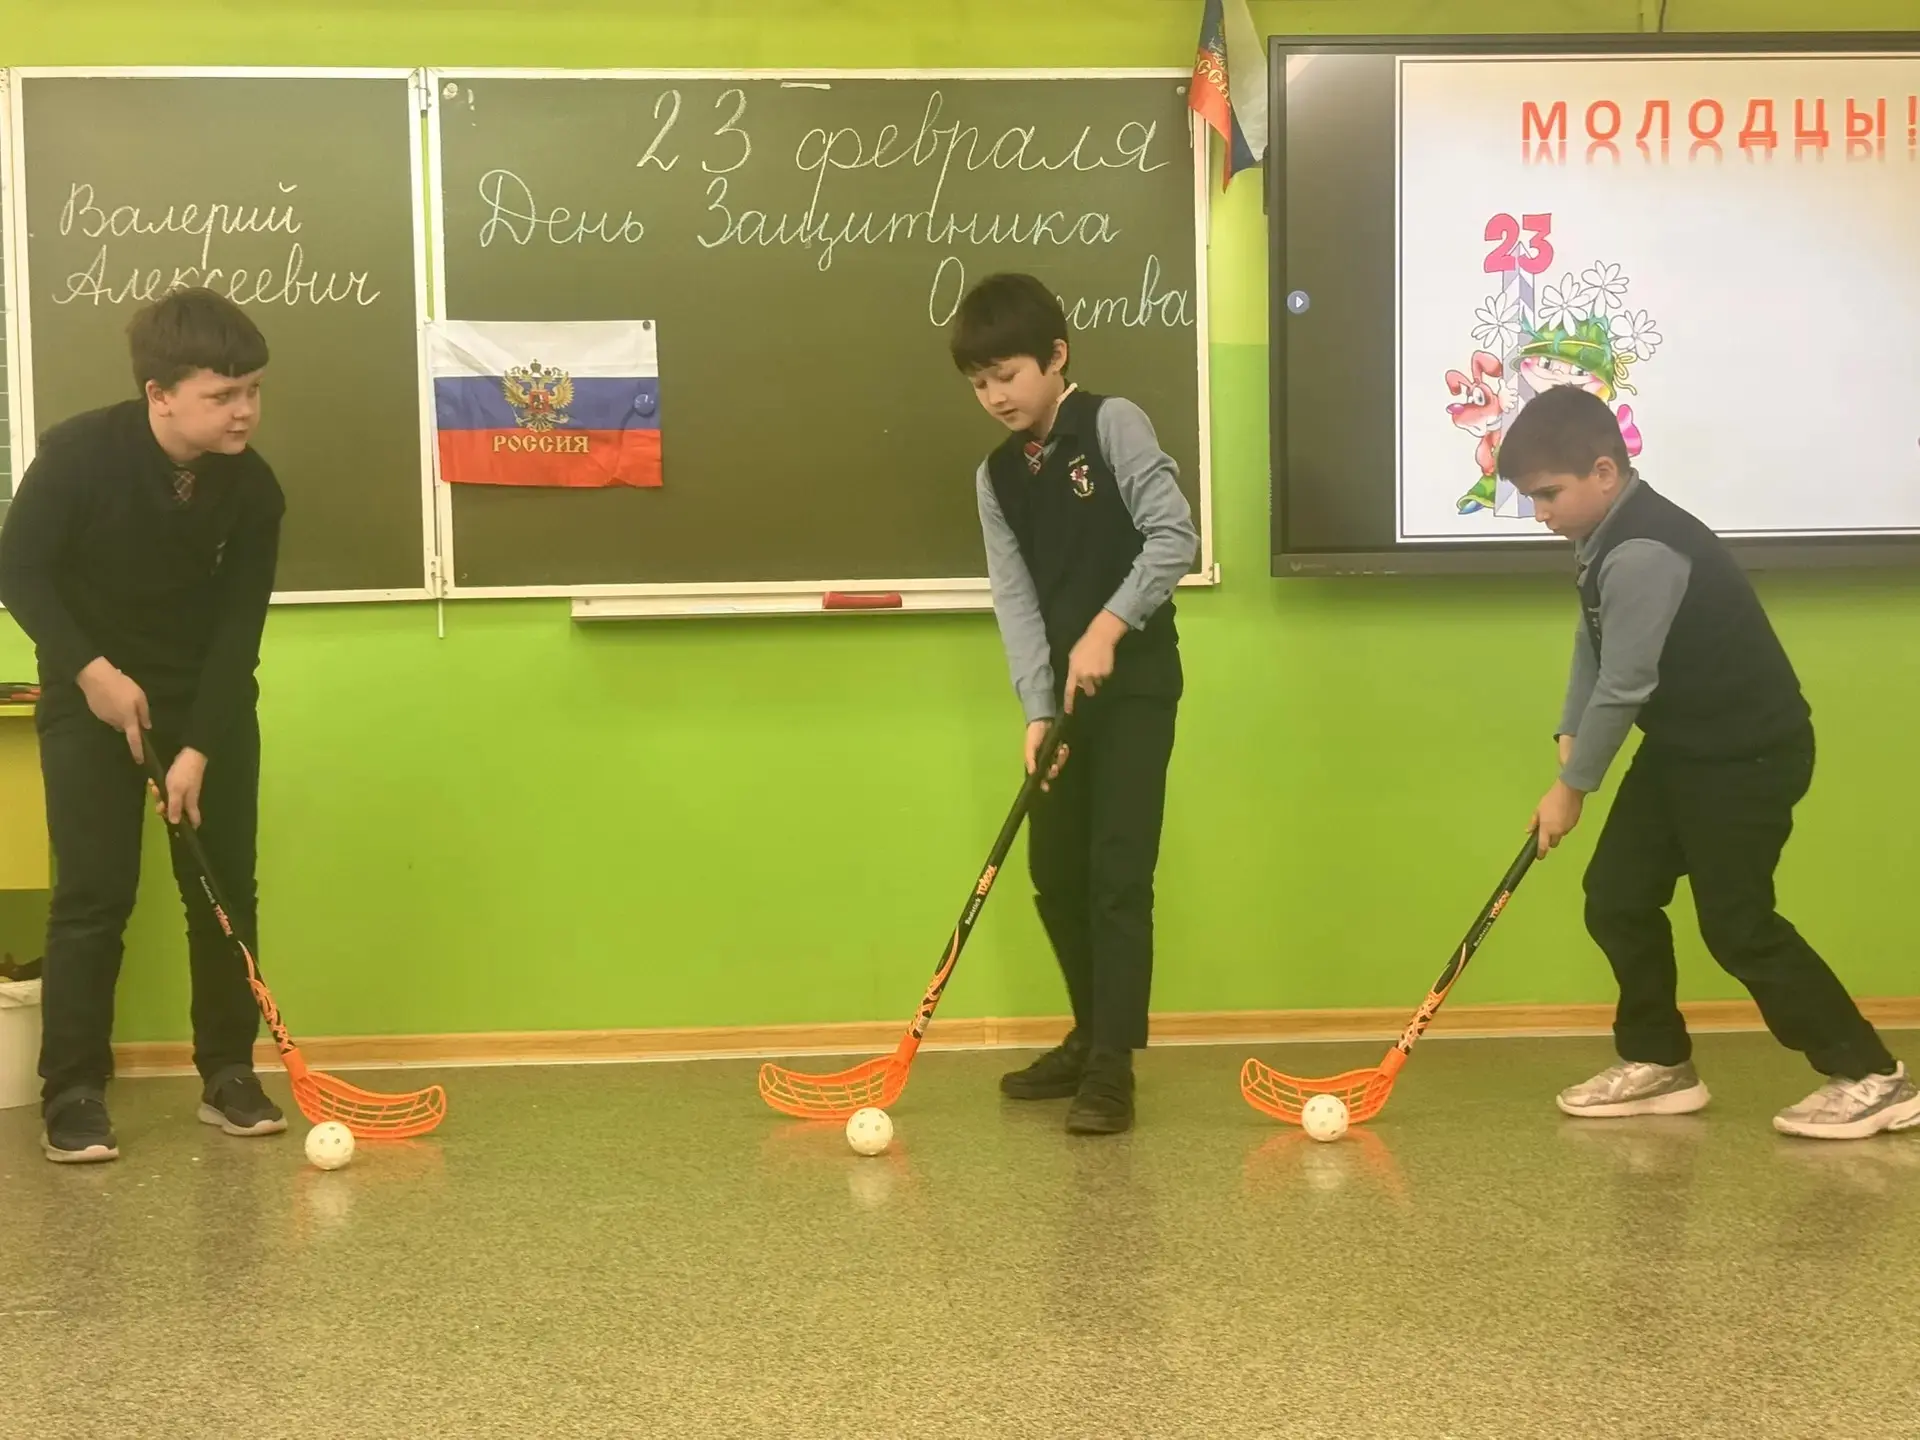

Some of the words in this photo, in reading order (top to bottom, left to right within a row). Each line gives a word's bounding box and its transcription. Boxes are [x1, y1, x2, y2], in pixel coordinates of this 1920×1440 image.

[637, 89, 751, 173] 23
[796, 91, 1170, 232] февраля
[1521, 96, 1918, 148] МОЛОДЦЫ!
[60, 182, 301, 270] Валерий
[479, 170, 644, 247] День
[697, 177, 1121, 271] Защитника
[1484, 213, 1554, 274] 23
[929, 254, 1193, 331] Оства
[492, 434, 590, 453] РОССИЯ
